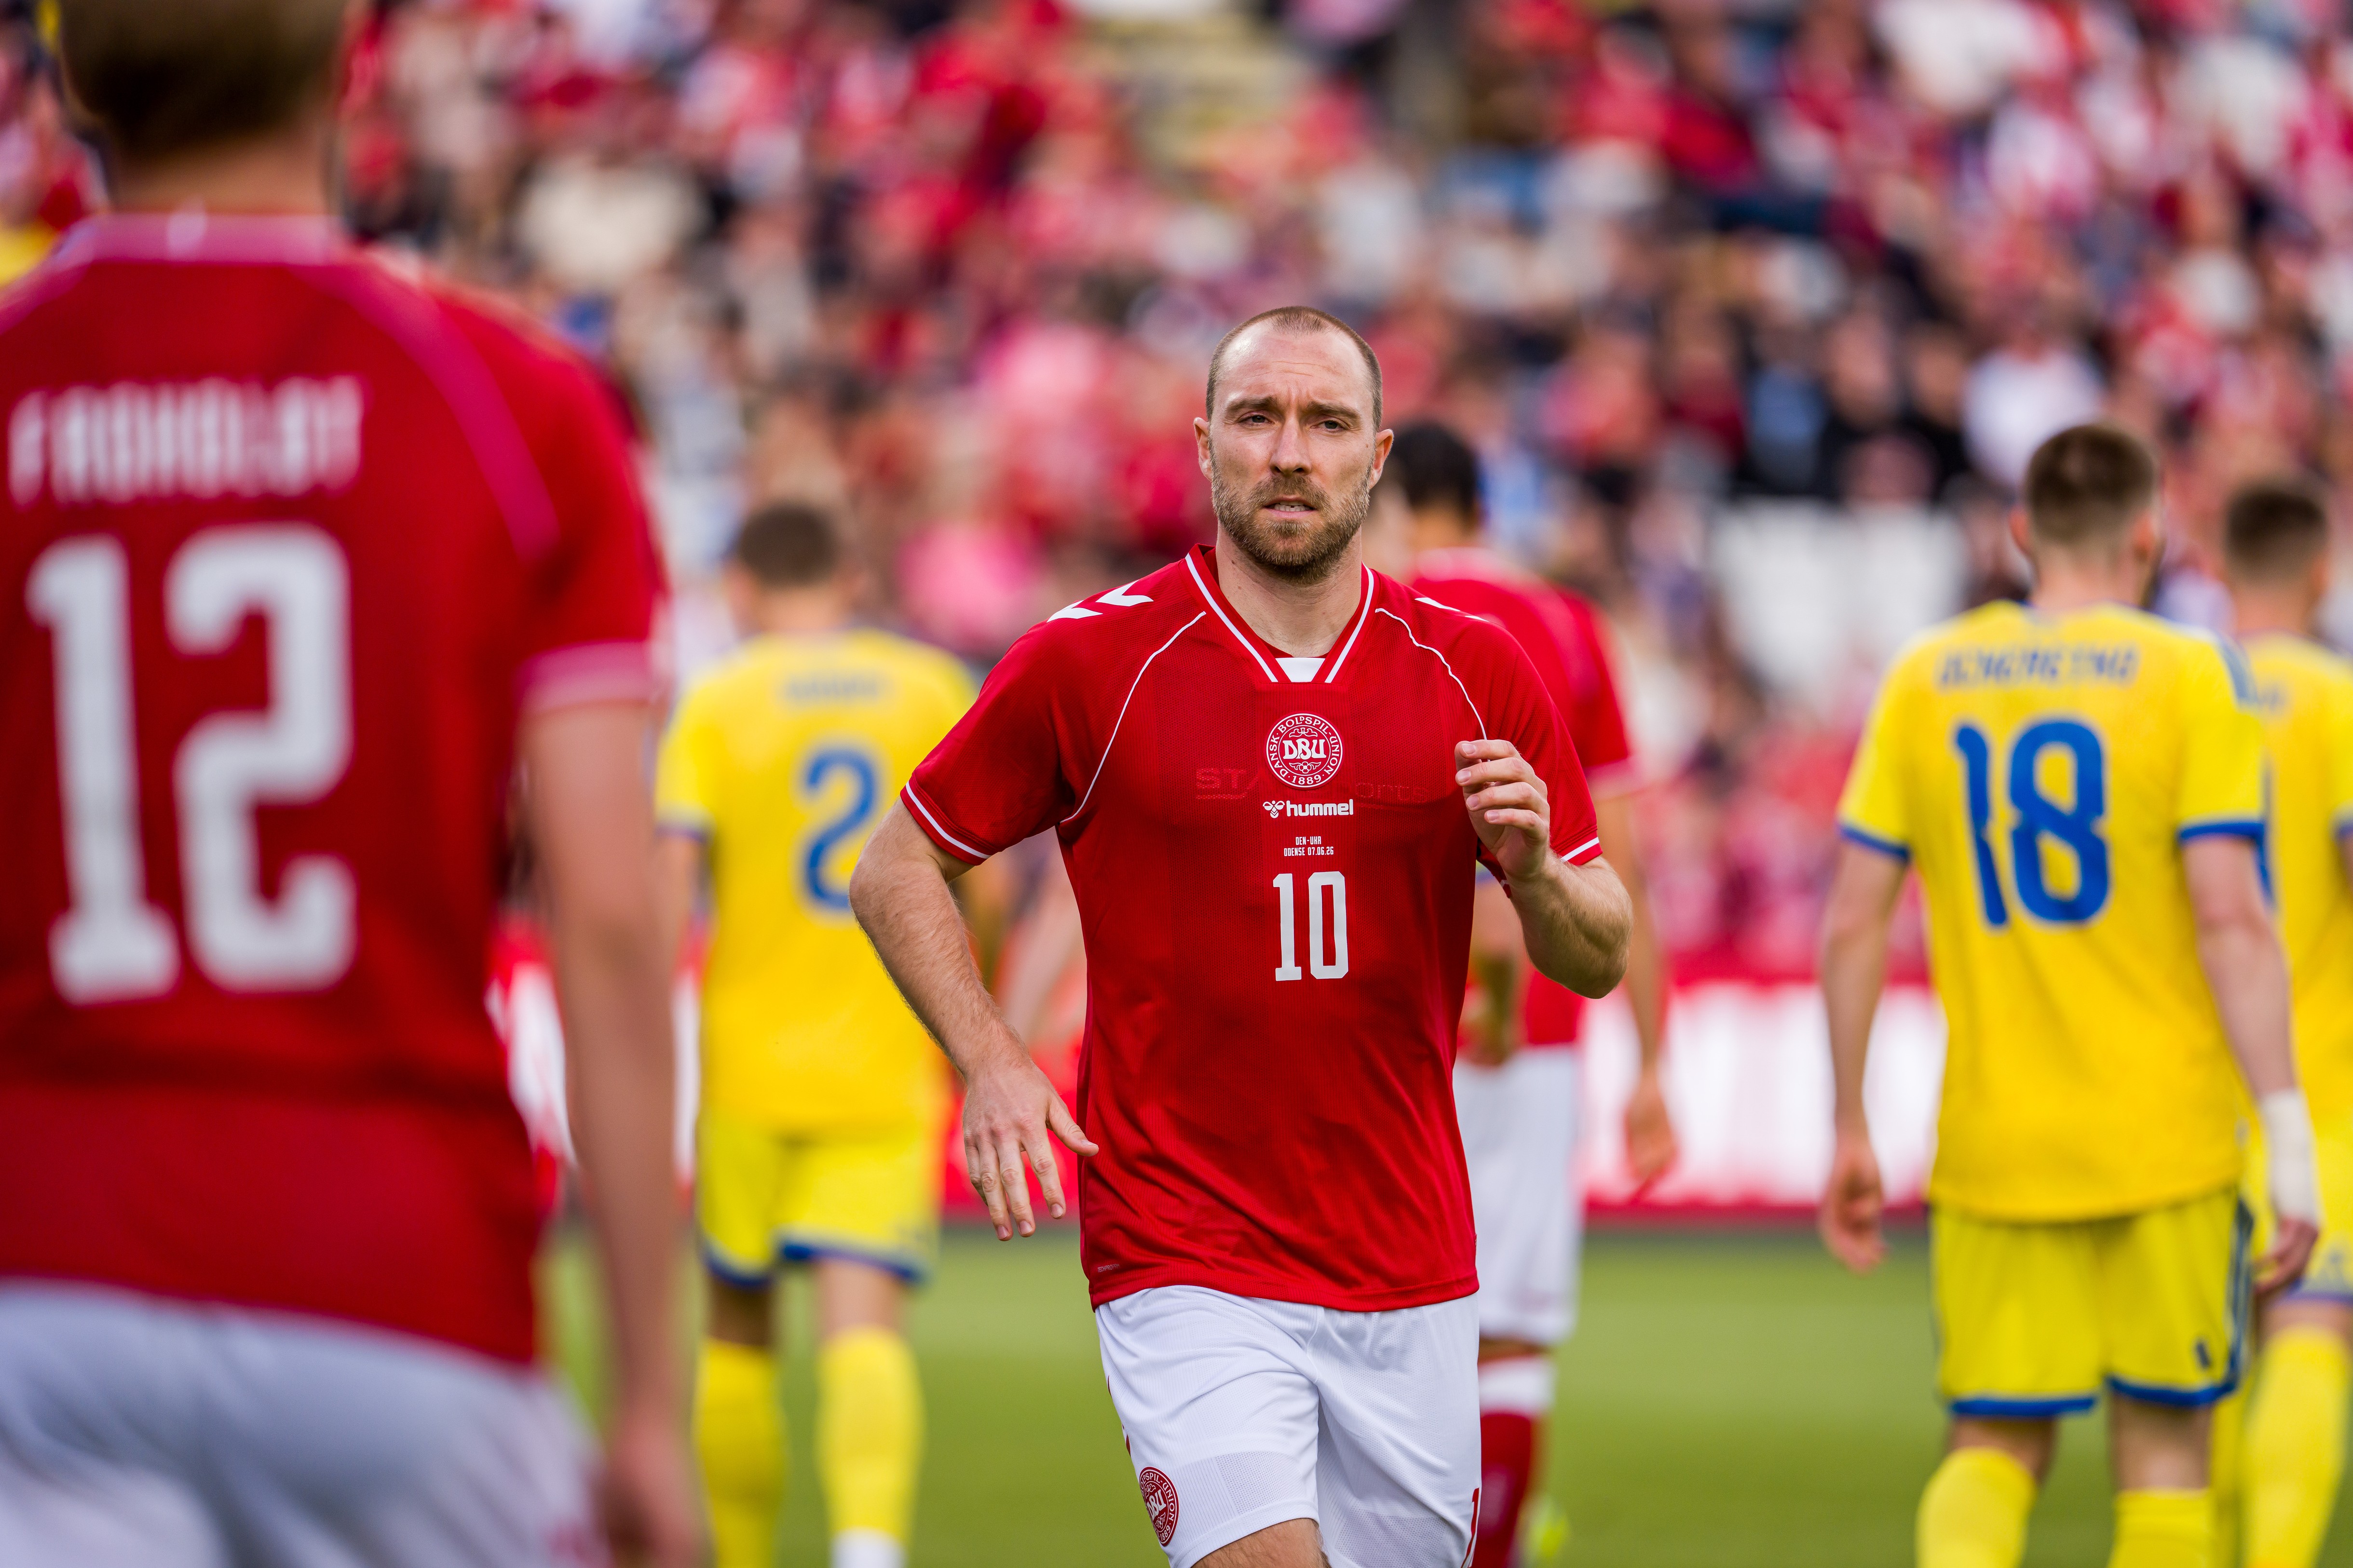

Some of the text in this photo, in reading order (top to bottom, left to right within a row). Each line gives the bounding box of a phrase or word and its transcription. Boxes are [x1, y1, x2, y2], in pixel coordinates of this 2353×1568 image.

[27, 523, 357, 1005] 12
[1269, 735, 1289, 778] DANSK
[1292, 774, 1321, 785] 1889
[1282, 738, 1327, 760] DBU
[802, 745, 879, 914] 2
[1286, 798, 1354, 817] hummel
[1956, 719, 2108, 926] 18
[1284, 846, 1334, 856] ODENSE 07.06.26
[1273, 871, 1348, 981] 10
